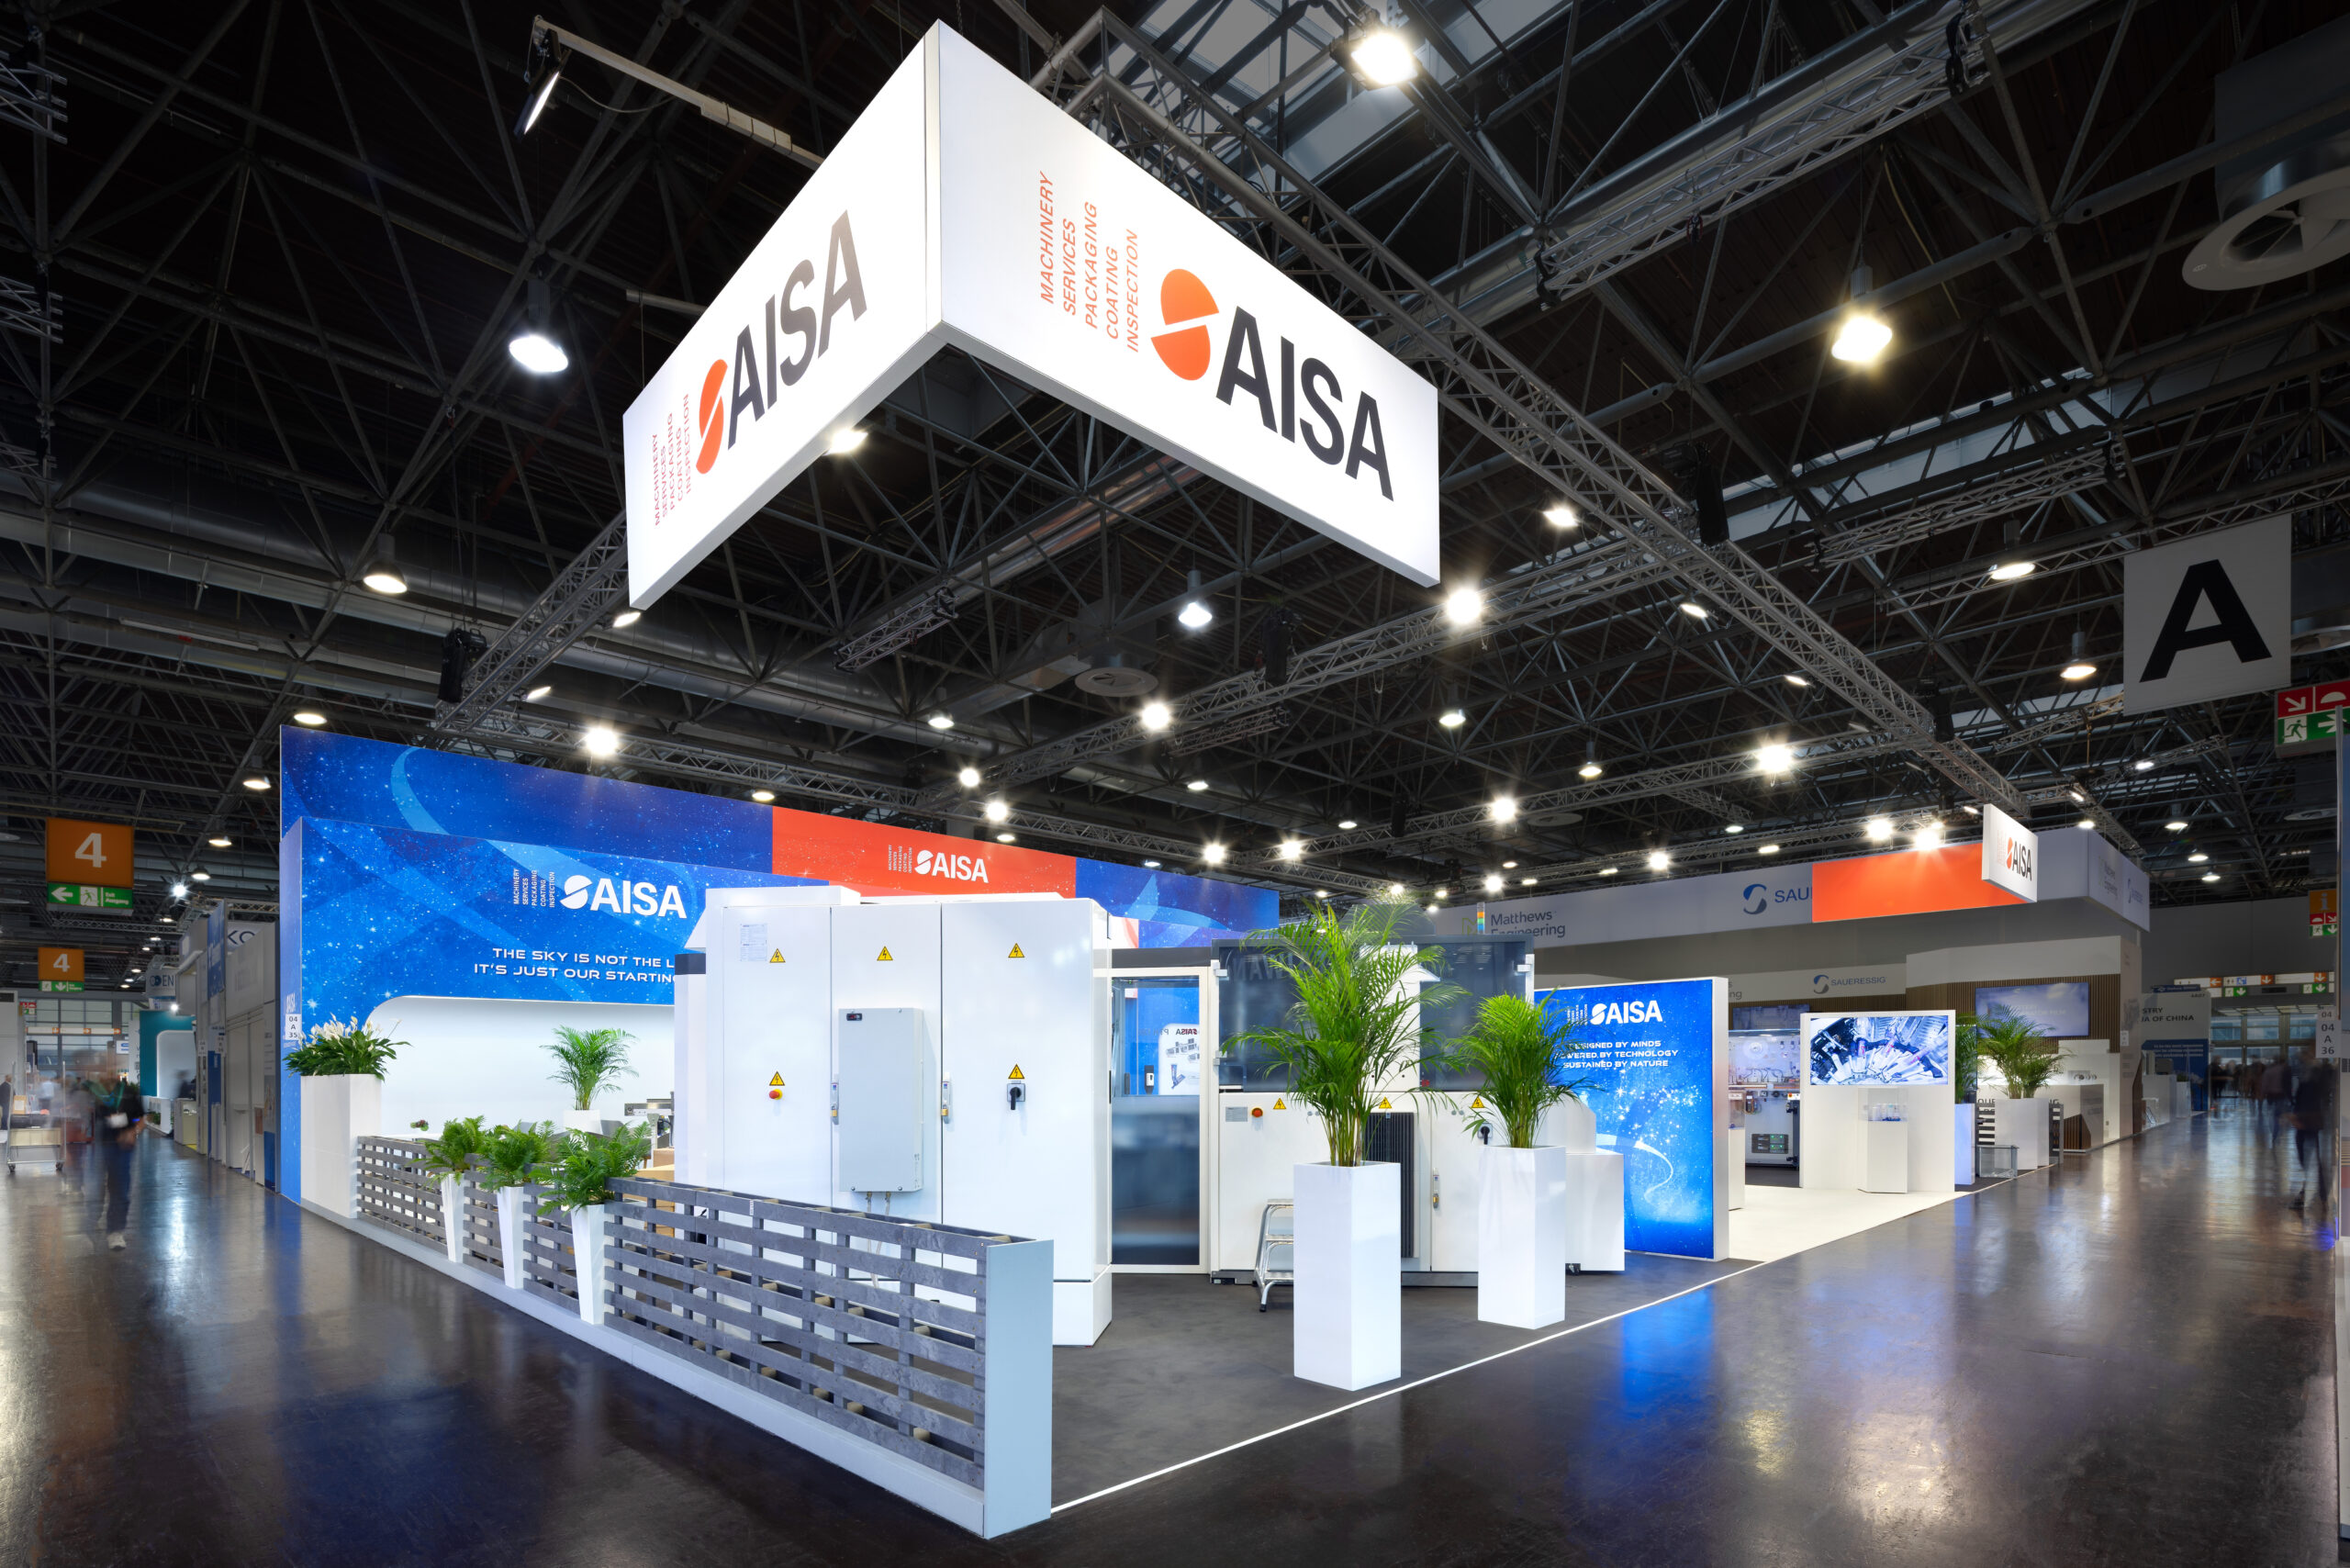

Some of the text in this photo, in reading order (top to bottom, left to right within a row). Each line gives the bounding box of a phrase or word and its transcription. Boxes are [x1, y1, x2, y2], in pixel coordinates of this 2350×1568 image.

[1040, 172, 1055, 305] MACHINERY
[1063, 218, 1076, 316] SERVICES
[1085, 201, 1098, 330] PACKAGING
[1106, 246, 1119, 340] COATING
[1126, 229, 1139, 353] INSPECTION
[728, 210, 867, 450] AISA
[1216, 306, 1393, 501] AISA
[2139, 559, 2272, 683] A
[75, 833, 106, 868] 4
[2012, 841, 2032, 881] AISA
[932, 852, 989, 883] AISA
[590, 878, 687, 919] AISA
[1491, 911, 1552, 926] Matthews
[53, 953, 71, 972] 4
[474, 963, 507, 975] IT'S
[513, 966, 558, 978] JUST
[564, 969, 600, 980] OUR
[492, 947, 526, 959] THE
[532, 950, 569, 962] SKY
[574, 953, 589, 963] IS
[595, 954, 628, 965] NOT
[632, 957, 661, 968] THE
[1830, 976, 1886, 986] SAUERESSIG
[1606, 1000, 1662, 1025] AISA
[2321, 1023, 2334, 1032] 04
[1615, 1049, 1679, 1058] TECHNOLOGY
[2321, 1047, 2334, 1055] 36
[2324, 1036, 2332, 1044] A
[1563, 1060, 1613, 1069] SUSTAINED
